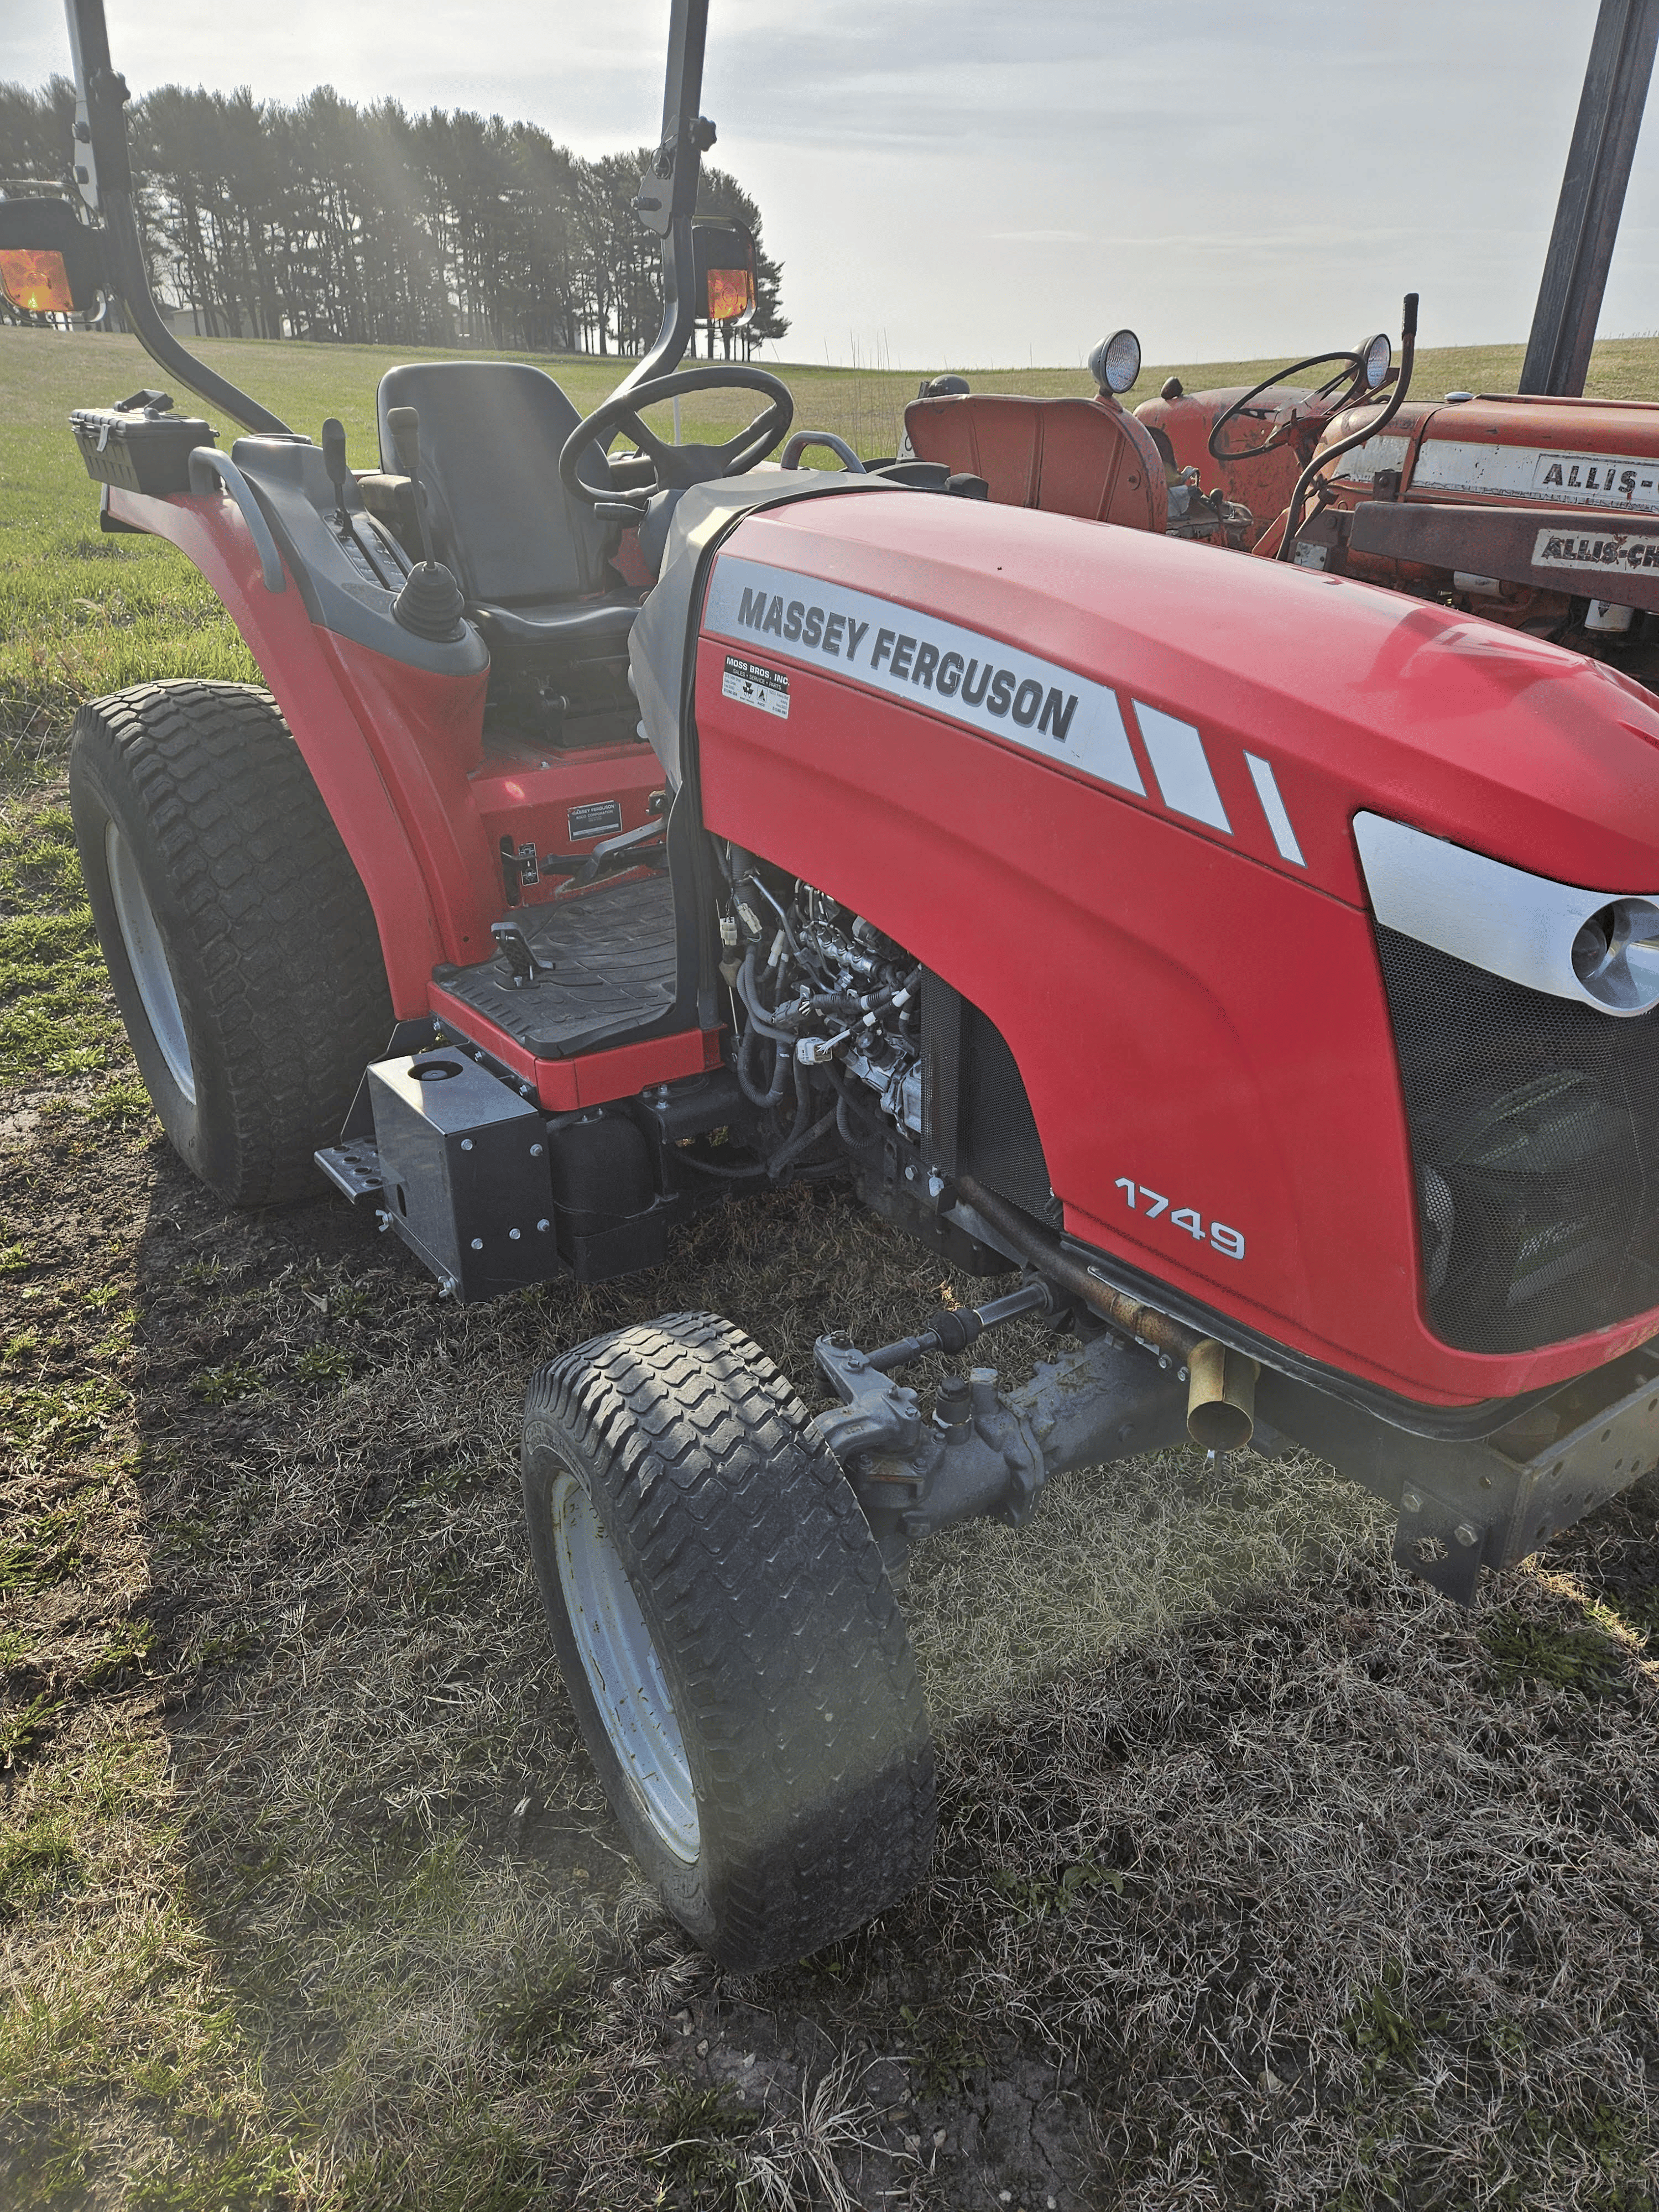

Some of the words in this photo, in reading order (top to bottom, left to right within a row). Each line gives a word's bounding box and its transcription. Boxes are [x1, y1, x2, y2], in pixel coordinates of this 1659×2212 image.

[1542, 463, 1659, 494] ALLIS-
[726, 656, 748, 671] MOSS
[774, 673, 790, 686] INC.
[733, 668, 745, 677] SALES
[749, 674, 765, 685] SERVICE
[769, 681, 782, 690] PARTS
[738, 586, 869, 661] MASSEY
[870, 627, 1079, 743] FERGUSON
[587, 809, 613, 817] CORPORATION
[591, 804, 615, 812] FERGUSON
[1114, 1176, 1245, 1260] 1749
